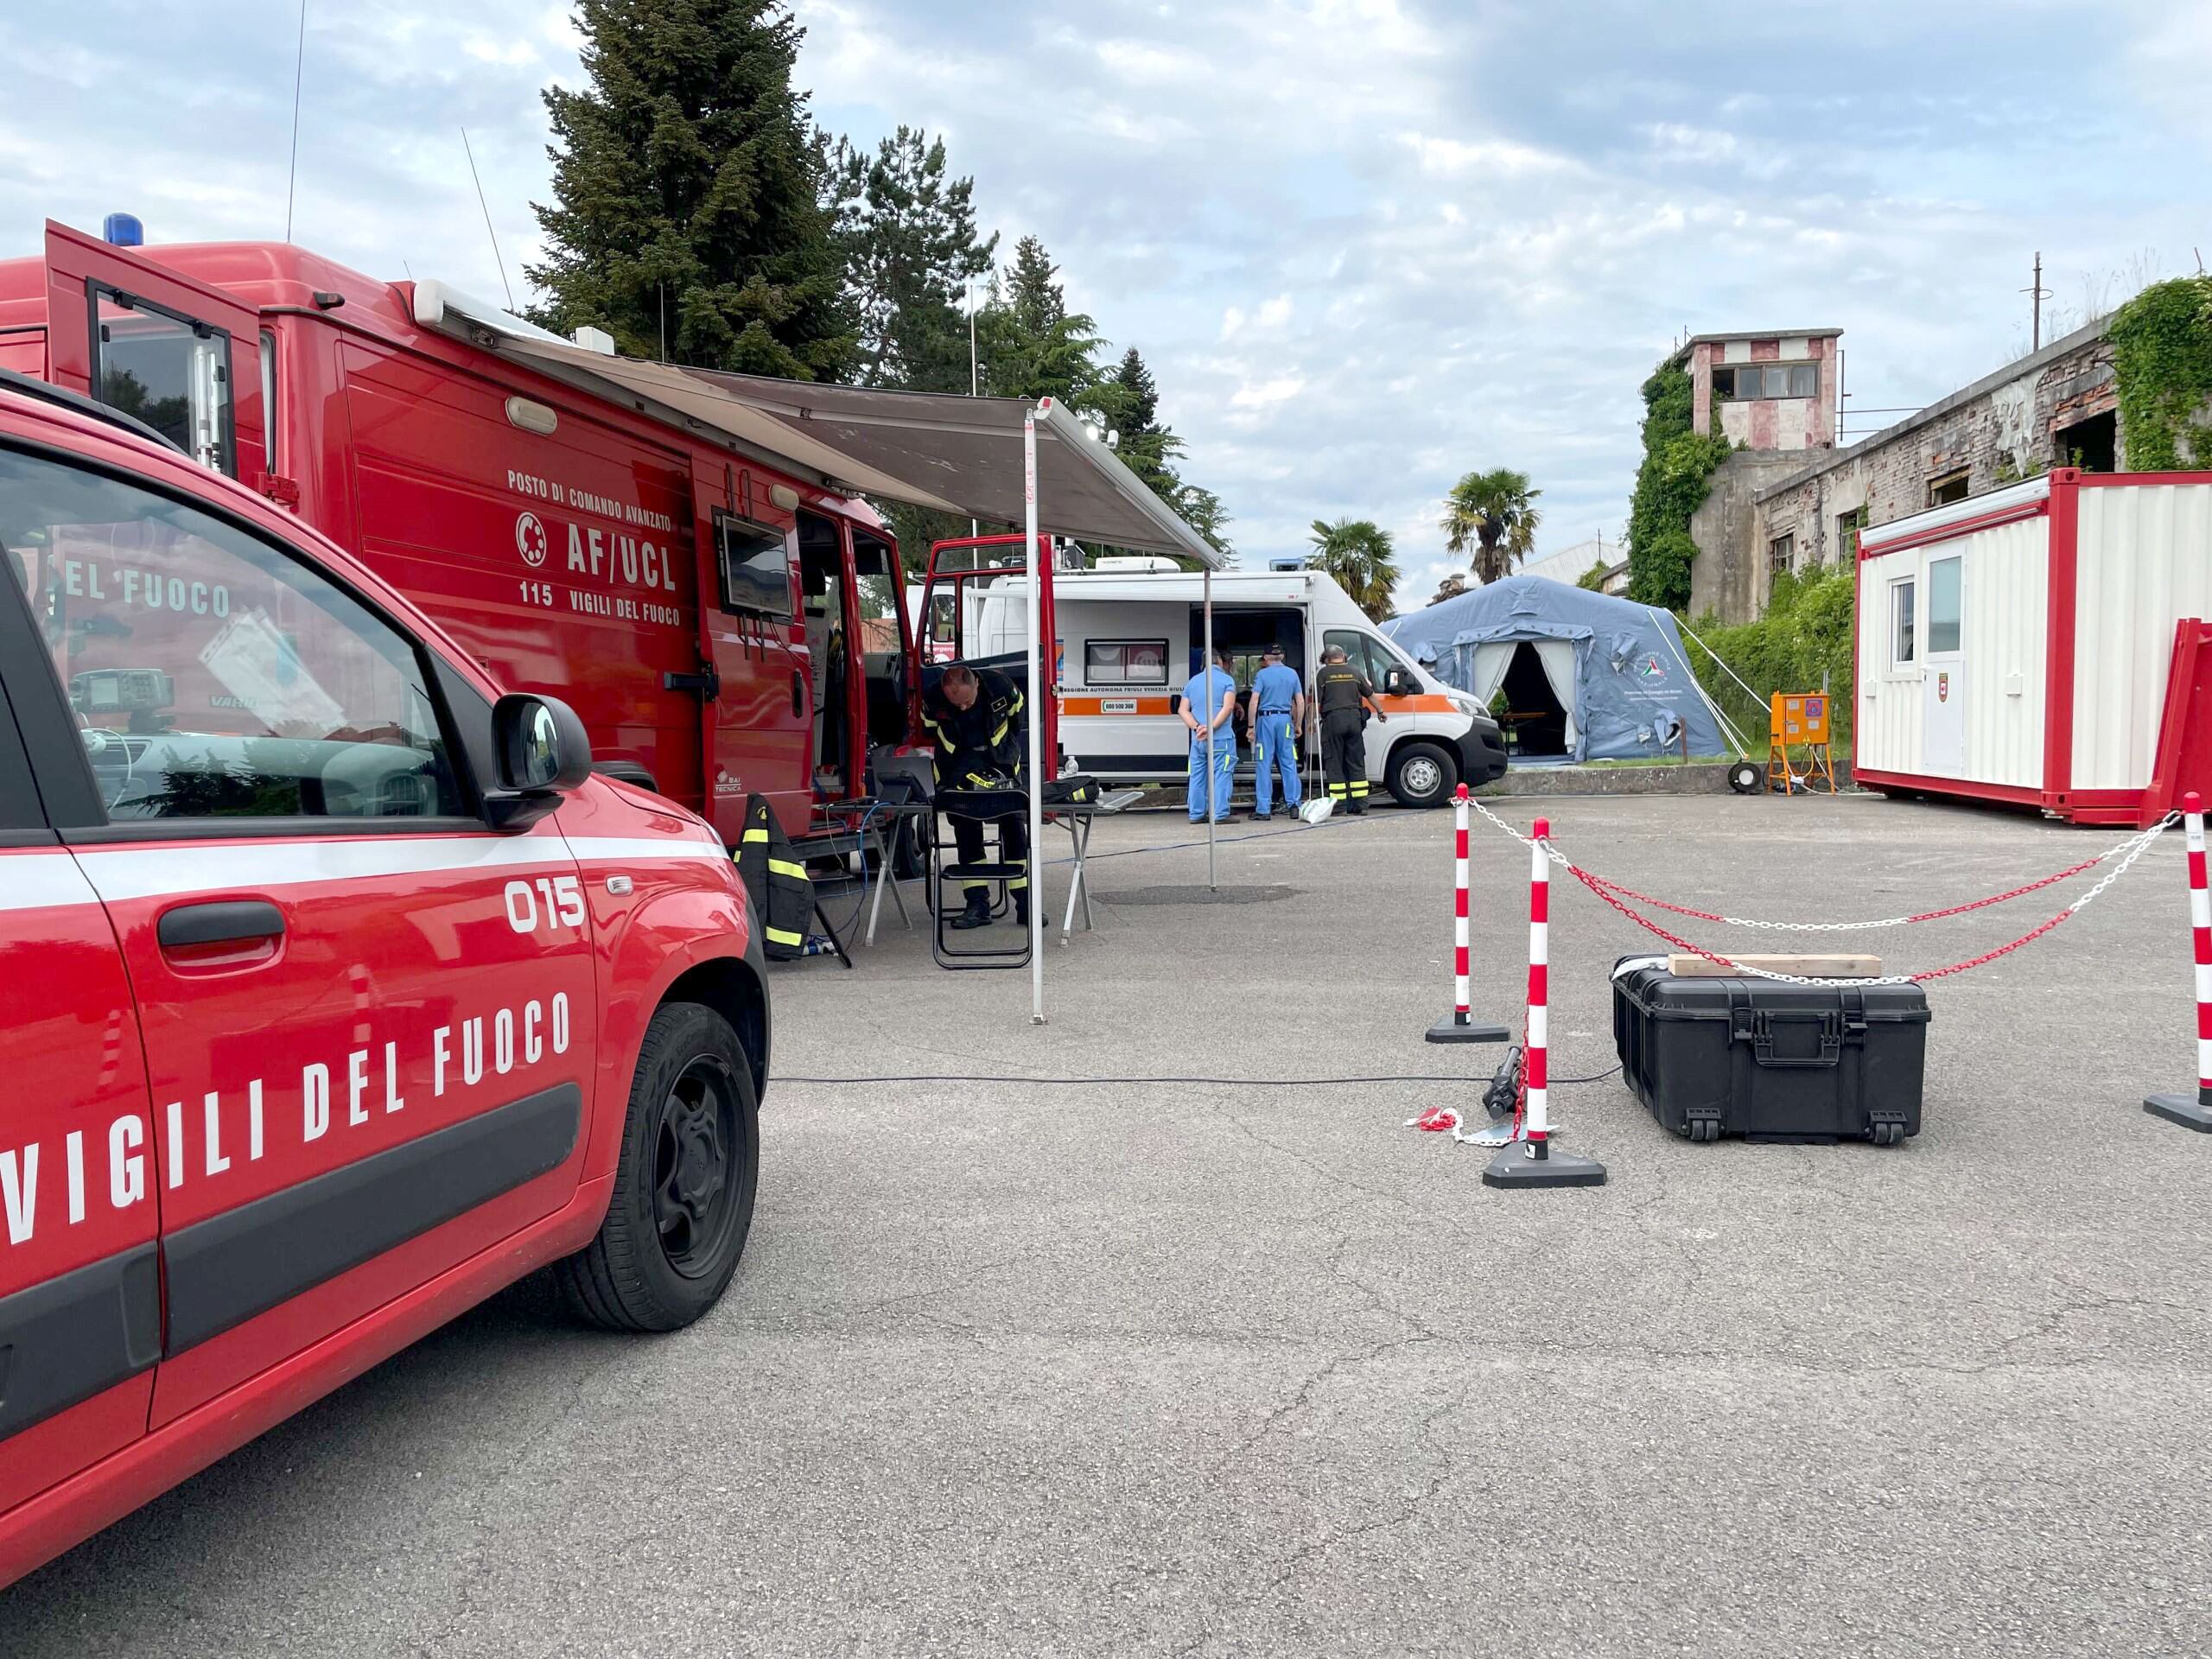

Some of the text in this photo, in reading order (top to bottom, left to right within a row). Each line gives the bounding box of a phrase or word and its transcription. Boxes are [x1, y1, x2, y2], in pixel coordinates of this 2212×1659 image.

[507, 469, 671, 532] POSTO DI COMANDO AVANZATO
[567, 523, 676, 591] AF/UCL
[124, 569, 230, 619] FUOCO
[519, 581, 553, 607] 115
[569, 590, 681, 626] VIGILI DEL FUOCO
[504, 875, 586, 934] 015
[0, 991, 570, 1246] VIGILI DEL FUOCO
